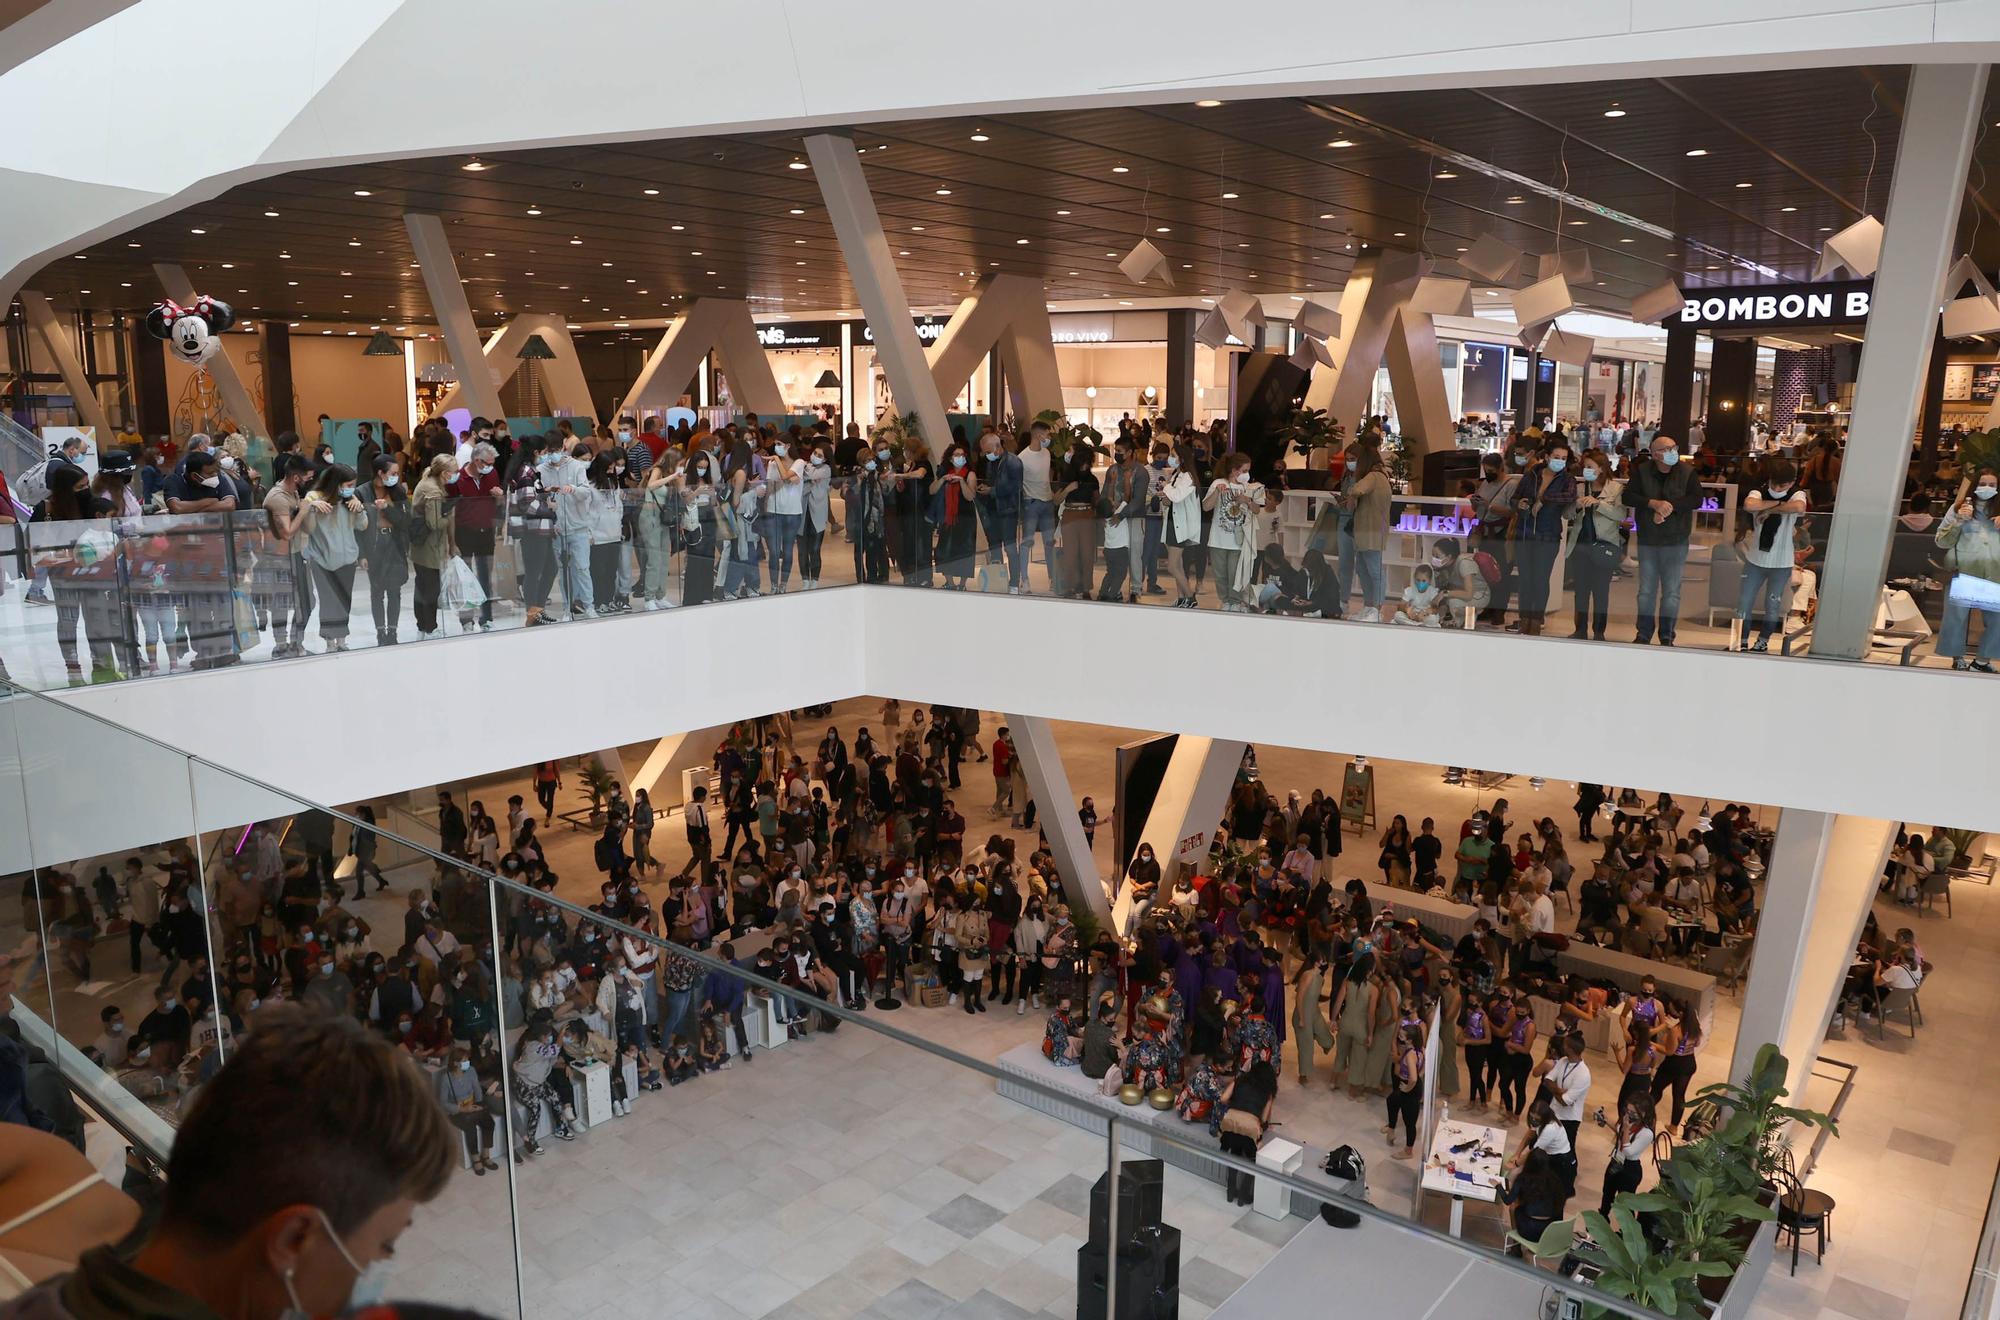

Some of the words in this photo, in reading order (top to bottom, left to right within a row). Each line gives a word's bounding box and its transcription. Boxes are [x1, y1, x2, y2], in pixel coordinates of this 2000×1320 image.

[1681, 294, 1832, 323] BOMBON
[1077, 332, 1108, 342] VIVO
[1396, 513, 1457, 534] JULES
